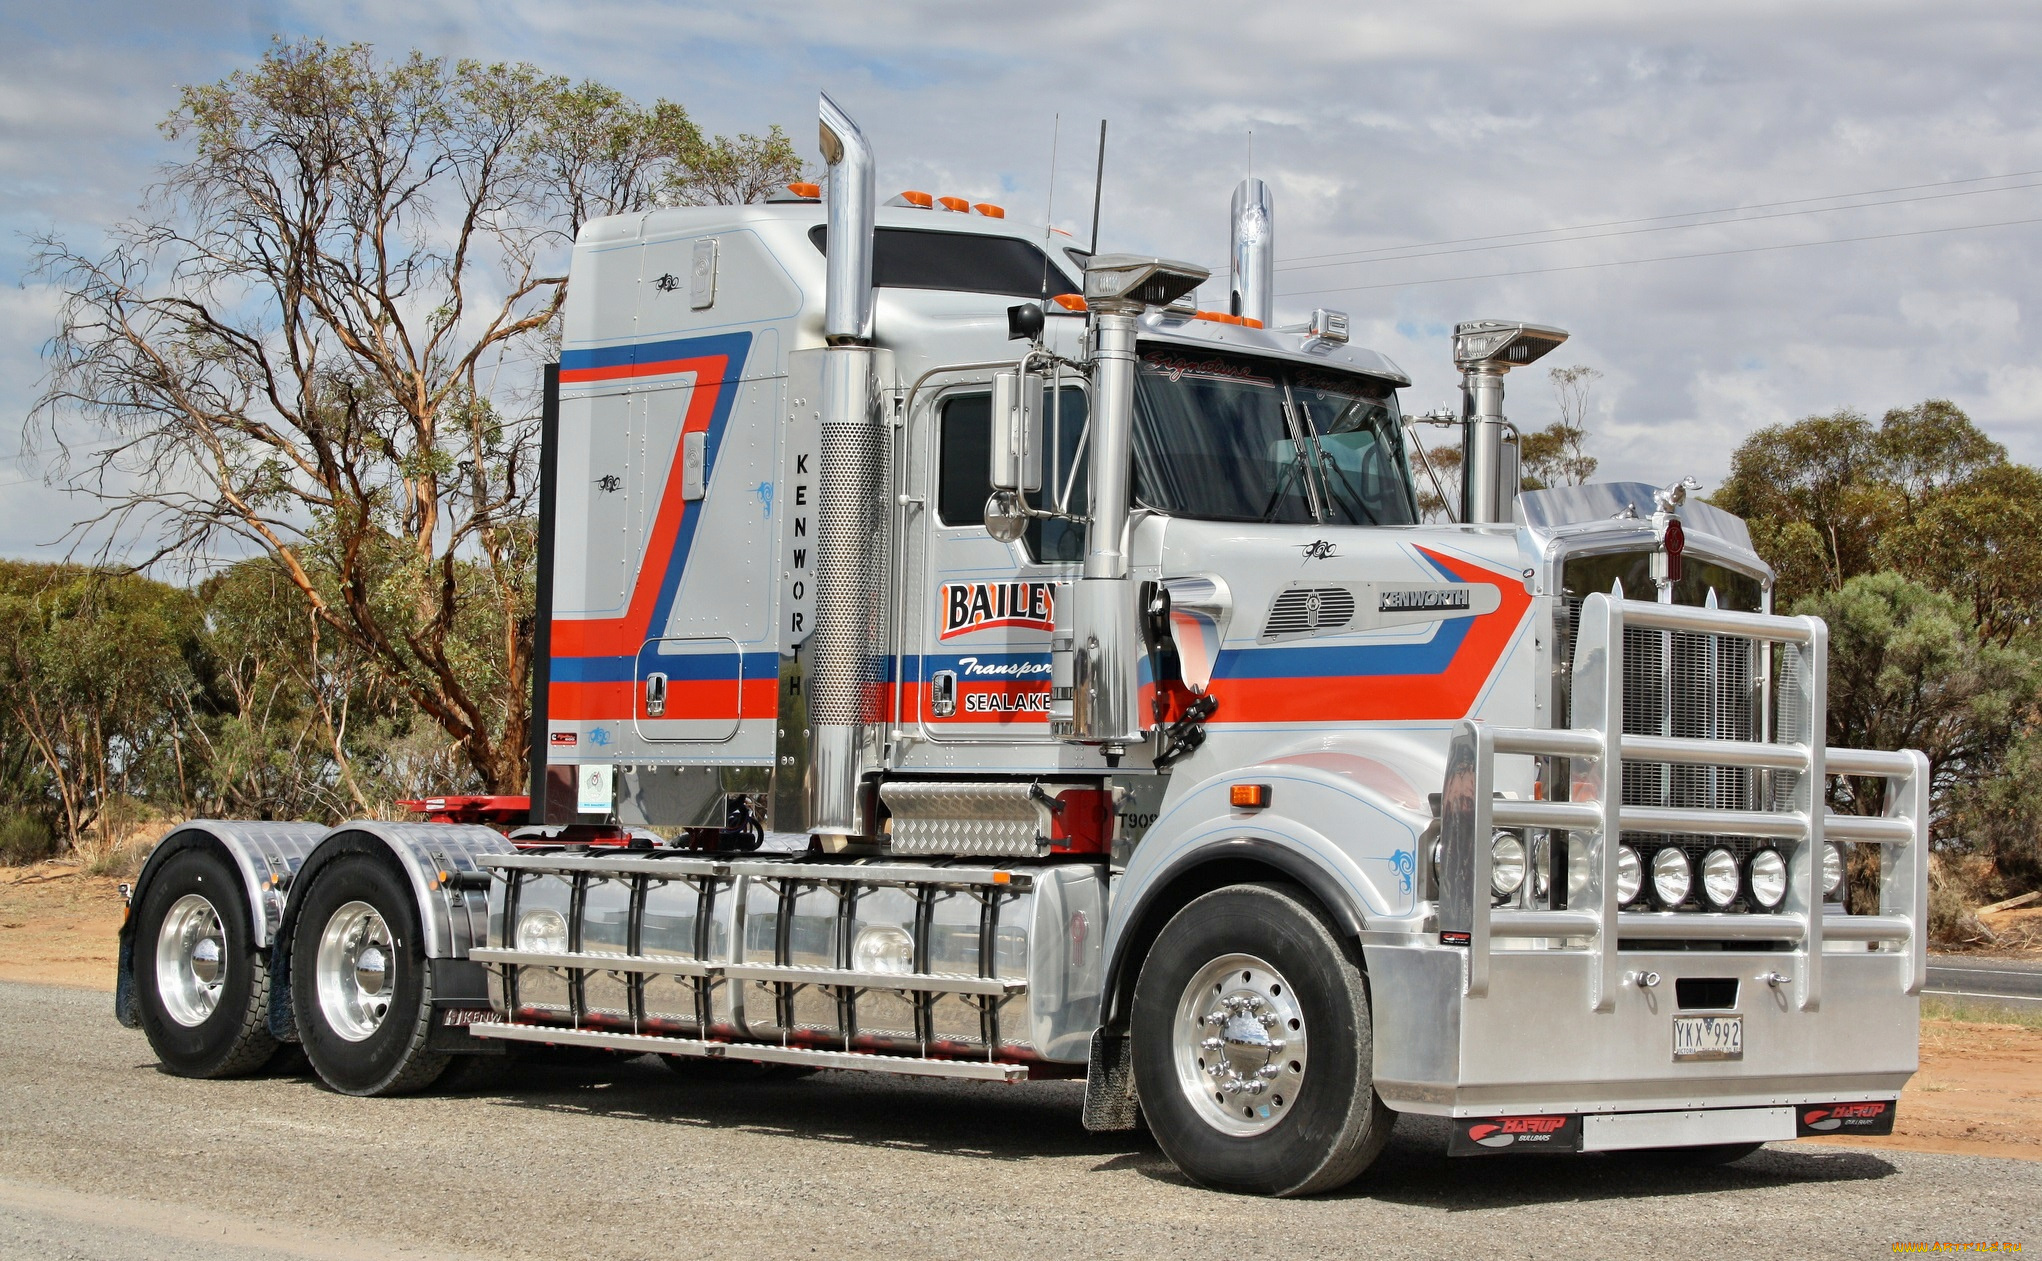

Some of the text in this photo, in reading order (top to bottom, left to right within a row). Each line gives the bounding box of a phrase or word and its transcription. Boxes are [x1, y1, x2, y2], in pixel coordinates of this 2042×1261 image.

[1143, 351, 1268, 384] Signature
[789, 454, 808, 696] KENWORTH
[1379, 589, 1470, 607] KENWORTH
[1676, 1022, 1739, 1047] YKX 992
